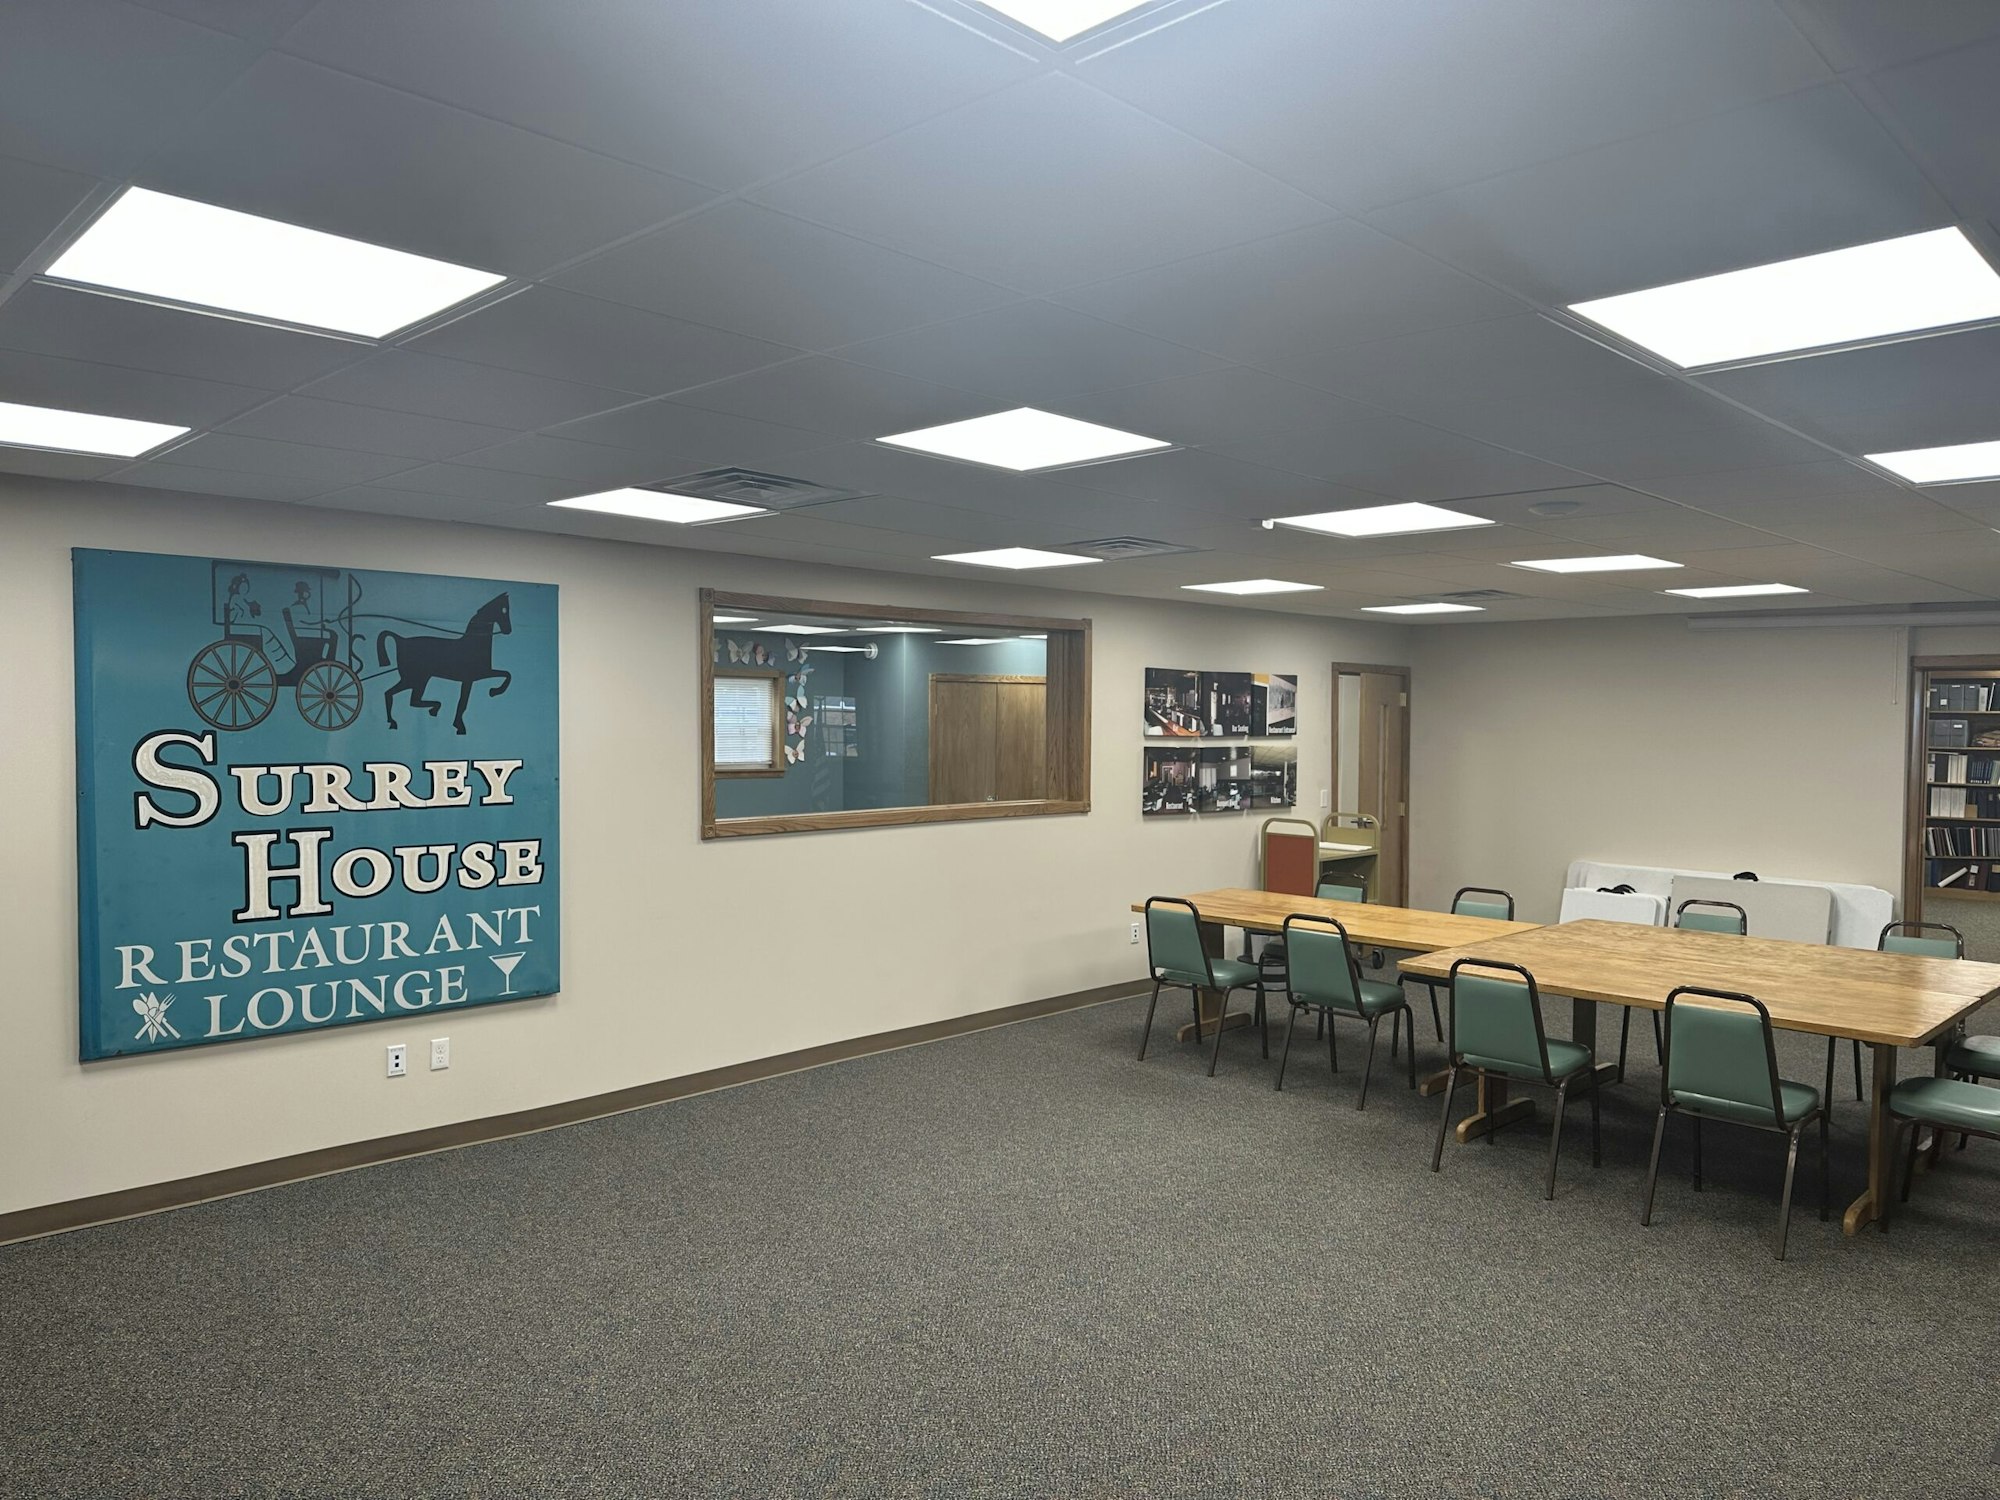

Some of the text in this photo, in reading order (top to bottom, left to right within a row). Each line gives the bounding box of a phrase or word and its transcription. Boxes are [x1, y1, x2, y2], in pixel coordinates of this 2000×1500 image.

[132, 729, 523, 829] SURREY
[231, 827, 544, 923] HOUSE
[115, 905, 540, 989] RESTAURANT
[204, 965, 467, 1037] LOUNGE
